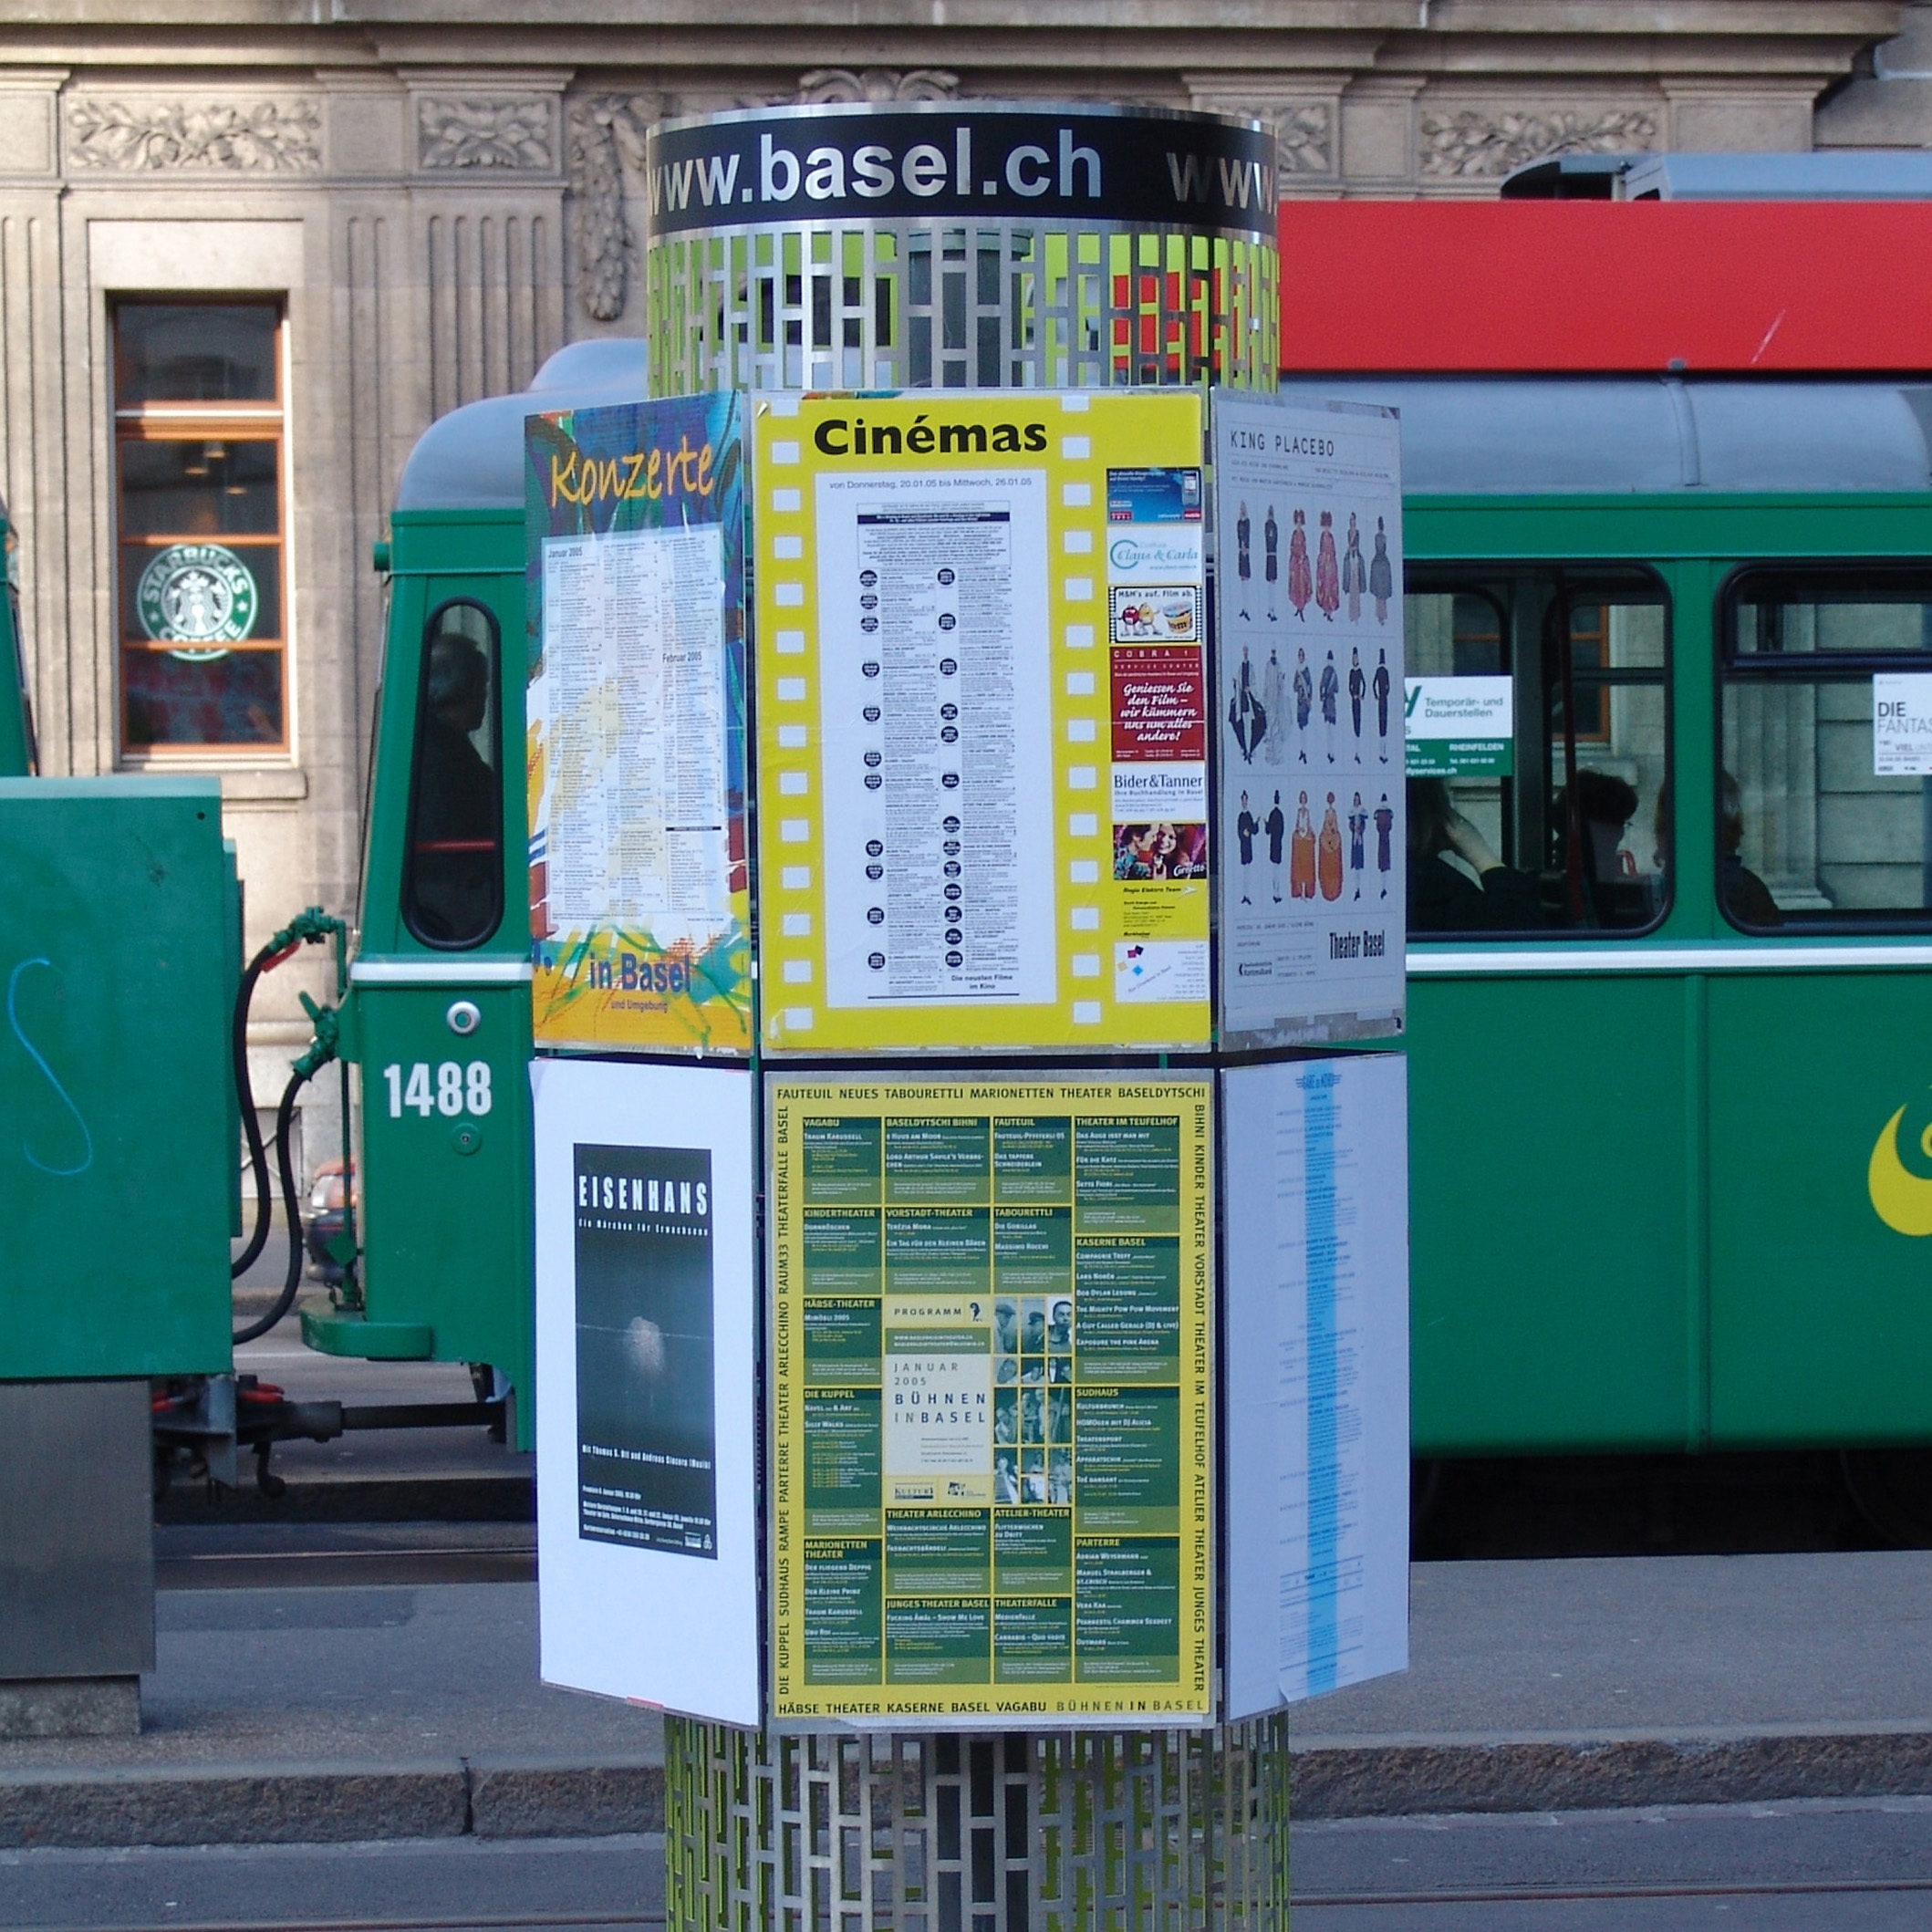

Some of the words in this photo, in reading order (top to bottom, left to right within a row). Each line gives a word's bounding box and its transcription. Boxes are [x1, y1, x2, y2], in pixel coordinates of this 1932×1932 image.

[814, 414, 1047, 455] Cinémas
[1231, 430, 1265, 451] KING
[1275, 435, 1335, 456] PLACEBO
[550, 434, 714, 508] Konzerte
[829, 482, 846, 490] von
[847, 480, 898, 490] Donnerstag,
[900, 479, 937, 488] 20.01.05
[939, 478, 952, 487] bis
[953, 478, 992, 488] Mittwoch,
[994, 477, 1032, 486] 26.01.05
[142, 545, 249, 603] STARBUCKS
[1124, 681, 1176, 697] Geniessen
[1176, 680, 1194, 693] Sie
[1127, 694, 1150, 705] den
[1151, 693, 1179, 705] Film
[1425, 697, 1480, 707] Temporär-
[1483, 697, 1503, 706] und
[1120, 706, 1141, 717] wir
[1141, 705, 1198, 717] kümmern
[1425, 709, 1493, 718] Dauerstellen
[1877, 701, 1906, 717] DIE
[1114, 774, 1203, 789] Bider&Tanner
[1329, 930, 1361, 960] Theater
[1363, 929, 1386, 957] Basel
[589, 951, 612, 990] in
[621, 951, 691, 992] Basel
[383, 1060, 492, 1118] 1488
[777, 1088, 833, 1099] FAUTEUIL
[839, 1088, 878, 1099] NEUES
[885, 1088, 963, 1098] TABOURETTLI
[970, 1088, 1054, 1098] MARIONETTEN
[1060, 1087, 1112, 1098] THEATER
[1118, 1087, 1205, 1098] BASELDYTSCHI
[777, 1106, 788, 1143] BASEL
[804, 1118, 840, 1127] VAGABU
[994, 1117, 1035, 1127] FAUTEUIL
[1076, 1117, 1116, 1127] THEATER
[1129, 1117, 1178, 1126] TEUFELHOF
[1195, 1104, 1205, 1138] BIHNI
[1195, 1145, 1205, 1189] KINDER
[578, 1175, 707, 1216] EISENHANS
[777, 1151, 788, 1239] THEATERFALLE
[804, 1210, 876, 1218] KINDERTHEATER
[994, 1209, 1053, 1217] TABOURETTLI
[1195, 1196, 1205, 1248] THEATER
[1076, 1238, 1117, 1247] KASERNE
[1118, 1238, 1146, 1247] BASEL
[778, 1244, 789, 1294] RAUM33
[1195, 1253, 1205, 1315] VORSTADT
[778, 1301, 789, 1377] ARLECCHINO
[1195, 1322, 1205, 1374] THEATER
[894, 1363, 959, 1373] JANUAR
[894, 1377, 927, 1386] 2005
[1195, 1380, 1205, 1395] IM
[805, 1390, 819, 1398] DIE
[821, 1390, 855, 1398] KUPPEL
[895, 1390, 985, 1405] BÜHNEN
[1076, 1388, 1119, 1397] SUDHAUS
[778, 1384, 789, 1436] THEATER
[1195, 1401, 1205, 1468] TEUFELHOF
[779, 1441, 789, 1502] PARTERRE
[1195, 1474, 1205, 1522] ATELIER
[887, 1510, 925, 1518] THEATER
[779, 1510, 789, 1551] RAMPE
[805, 1540, 867, 1549] MARIONETTEN
[1076, 1539, 1120, 1547] PARTERRE
[805, 1550, 844, 1559] THEATER
[1194, 1529, 1205, 1581] THEATER
[779, 1558, 789, 1615] SUDHAUS
[887, 1600, 921, 1609] JUNGES
[922, 1599, 961, 1608] THEATER
[961, 1599, 990, 1608] BASEL
[995, 1599, 1057, 1608] THEATERFALLE
[1193, 1586, 1205, 1633] JUNGES
[779, 1623, 789, 1668] KUPPEL
[1194, 1640, 1204, 1691] THEATER
[779, 1675, 789, 1694] DIE
[778, 1701, 819, 1714] HÄBSE
[826, 1703, 880, 1714] THEATER
[887, 1702, 944, 1713] KASERNE
[951, 1702, 990, 1712] BASEL
[996, 1702, 1046, 1712] VAGABU
[1056, 1699, 1123, 1711] BÜHNEN
[1129, 1701, 1146, 1710] IN
[1153, 1700, 1203, 1710] BASEL
